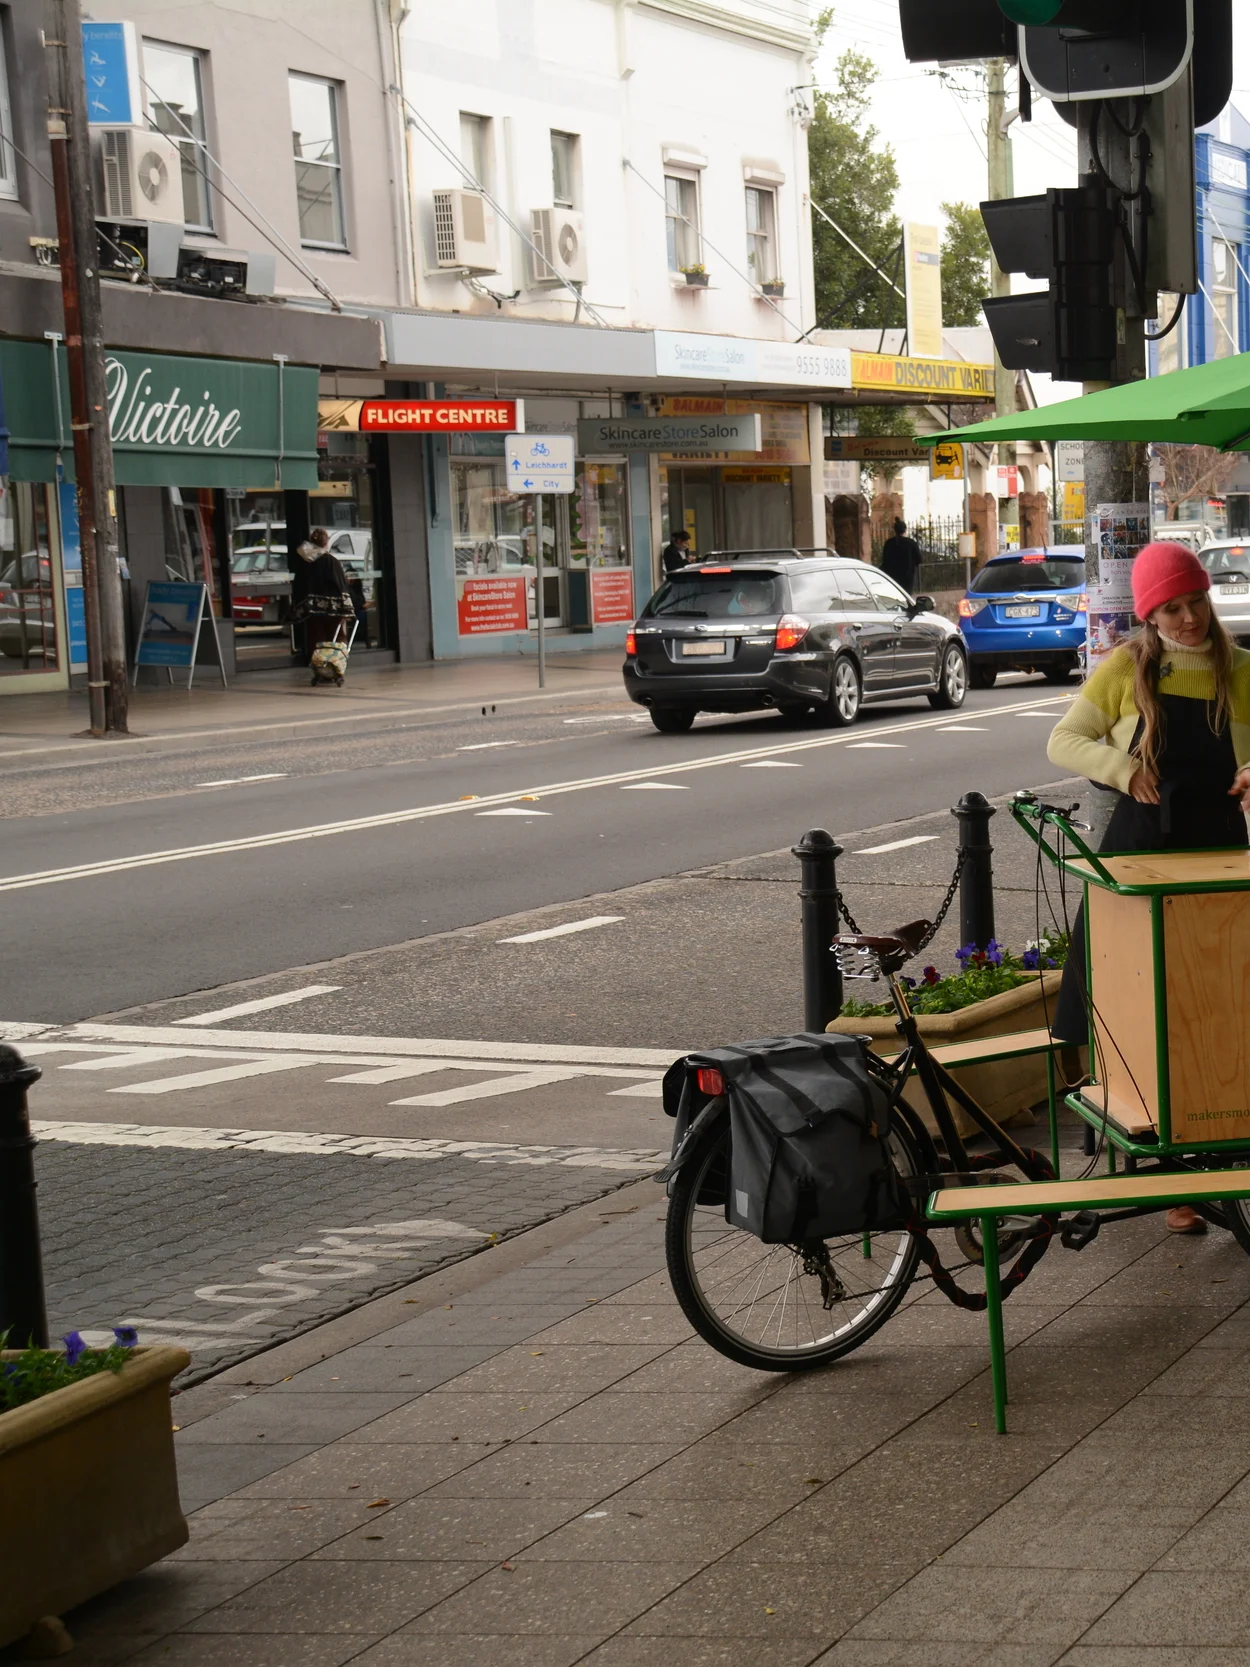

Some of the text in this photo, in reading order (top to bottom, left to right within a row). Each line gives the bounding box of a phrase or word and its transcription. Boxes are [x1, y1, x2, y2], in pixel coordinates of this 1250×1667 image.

[796, 355, 820, 375] 9555
[824, 358, 847, 378] 9888
[895, 361, 957, 388] DISCOUNT
[105, 357, 241, 448] Victoire
[673, 398, 724, 413] BALMAIN
[366, 408, 509, 424] FLIGHT CENTRE
[599, 424, 739, 442] SkincareStoreSalon
[608, 440, 709, 450] www.skincarestore.com.au
[863, 447, 931, 457] Discount Var
[1060, 443, 1084, 451] SCHOO
[525, 461, 567, 470] Leichhardt
[543, 480, 560, 489] City
[119, 1235, 431, 1333] LOOK
